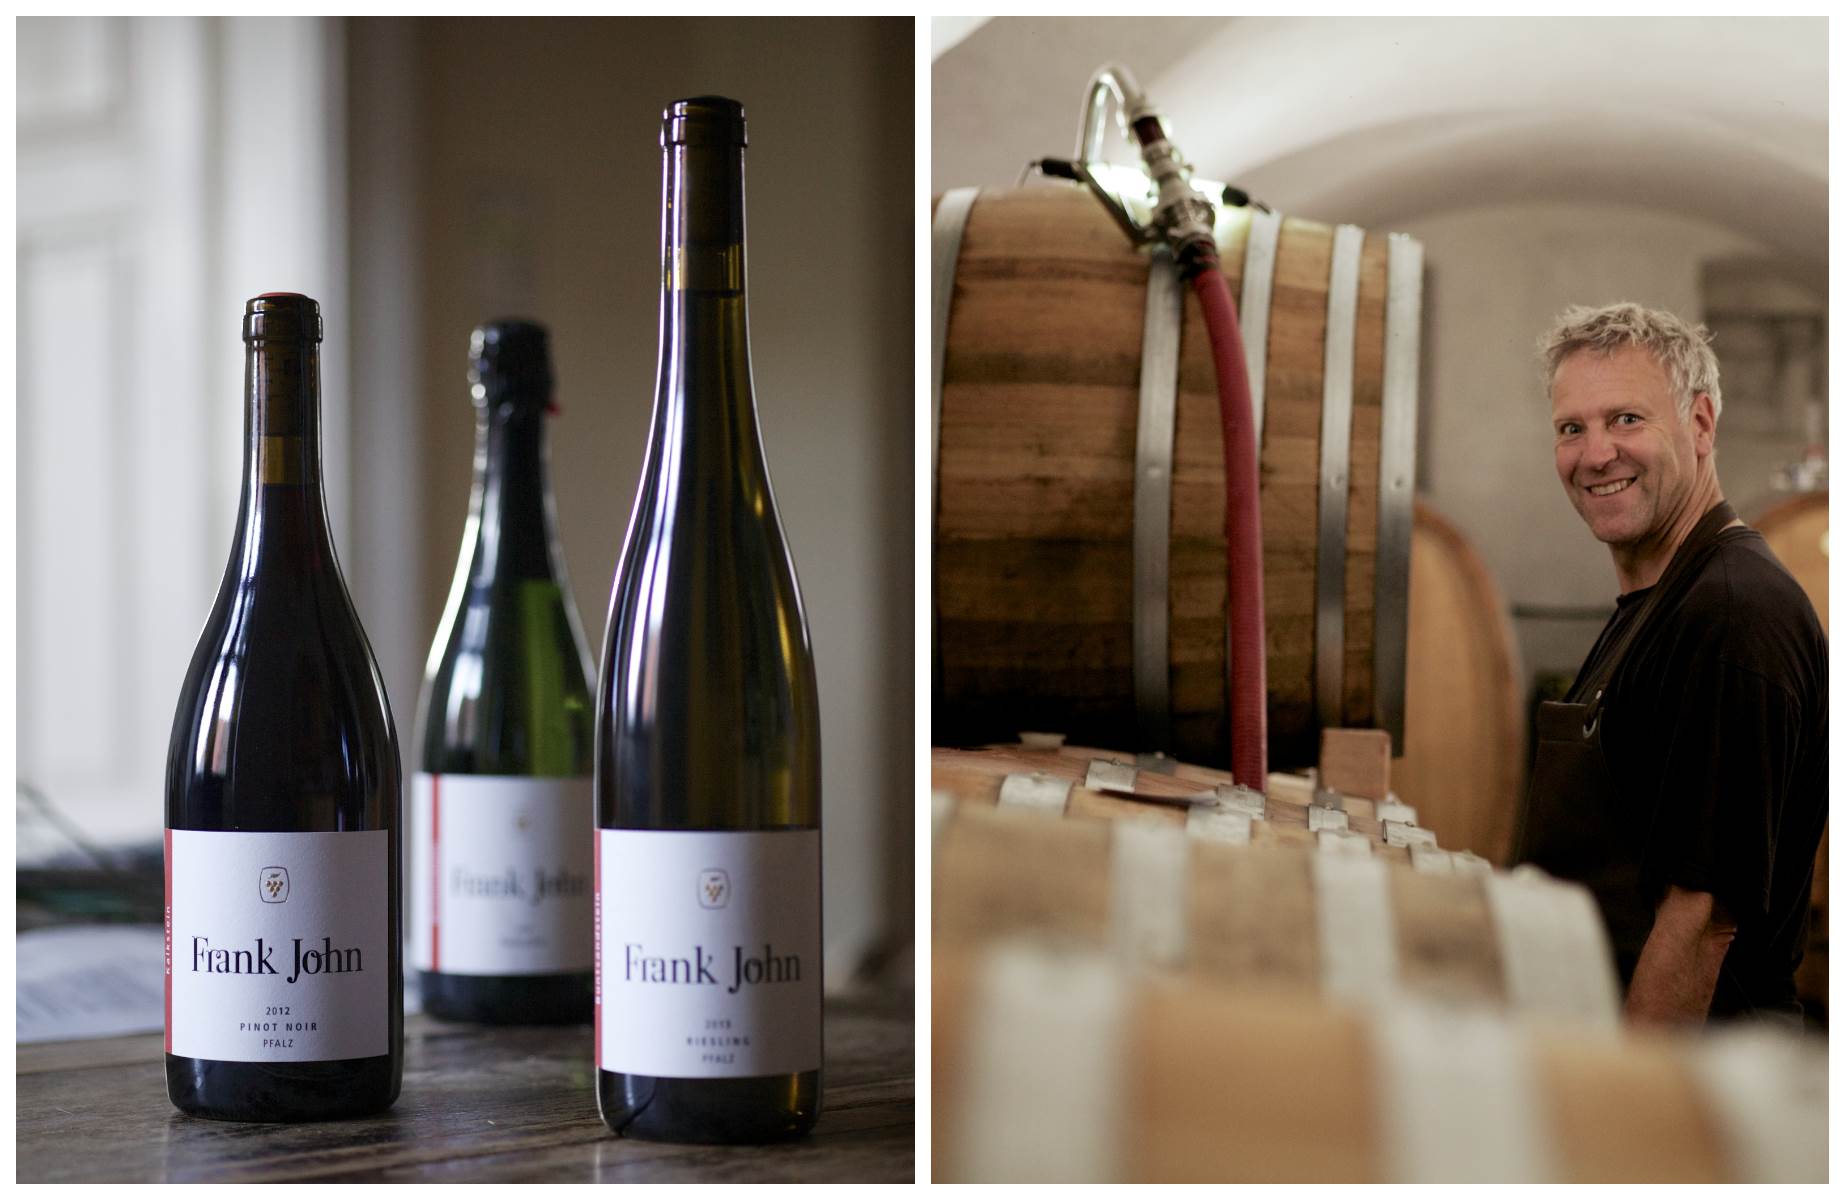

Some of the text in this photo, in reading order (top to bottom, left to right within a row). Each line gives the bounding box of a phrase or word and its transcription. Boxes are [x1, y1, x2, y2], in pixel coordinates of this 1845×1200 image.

[191, 935, 364, 984] Frank John
[624, 943, 802, 995] Frank John
[265, 1006, 291, 1016] 2012
[240, 1022, 318, 1032] PINOT NOIR
[263, 1039, 294, 1048] PFALZ
[686, 1036, 751, 1047] RIESLING
